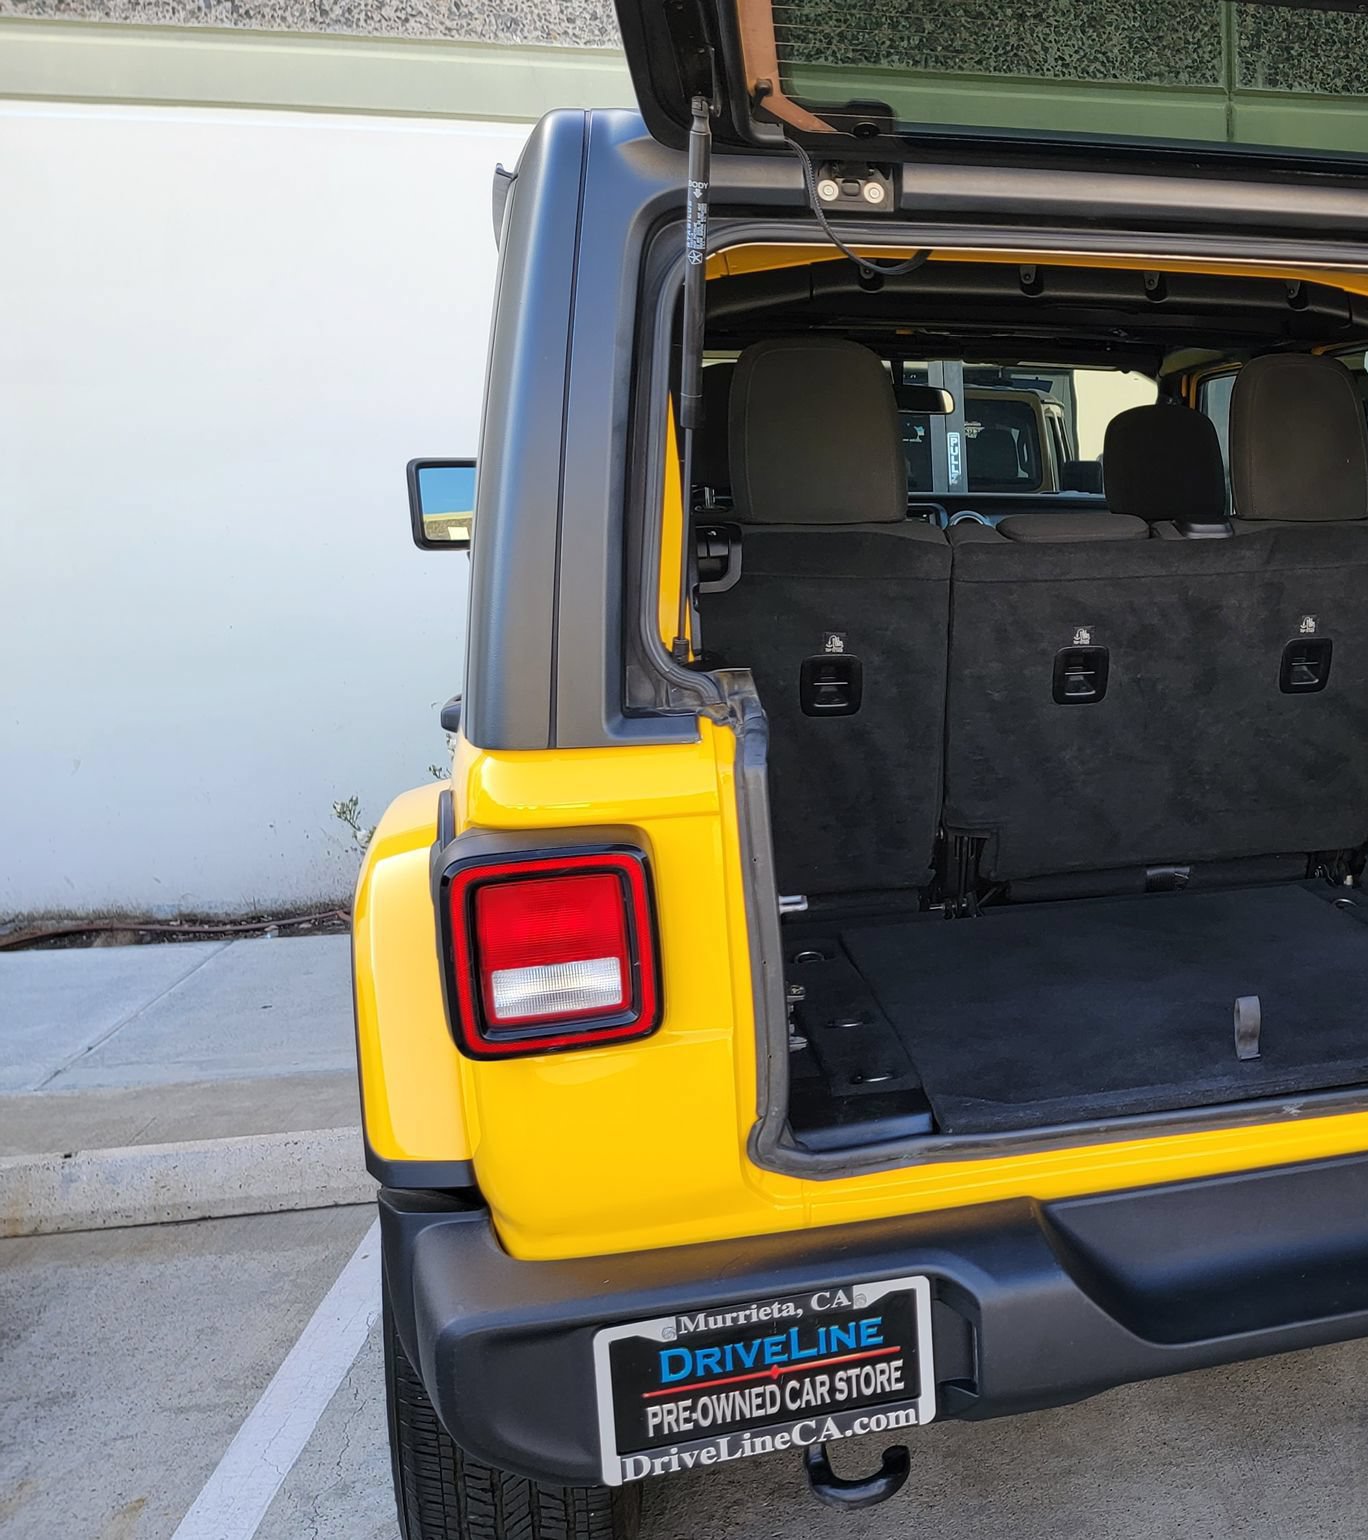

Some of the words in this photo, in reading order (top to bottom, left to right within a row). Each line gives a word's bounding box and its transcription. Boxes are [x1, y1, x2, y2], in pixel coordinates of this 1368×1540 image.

[688, 180, 709, 189] BODY
[950, 437, 959, 473] PULL
[676, 1302, 804, 1335] Murrieta,
[811, 1290, 852, 1311] CA
[646, 1384, 780, 1438] PRE-OWNED
[785, 1374, 834, 1408] CAR
[837, 1359, 905, 1402] STORE
[621, 1407, 918, 1482] DriveLineCA.com
